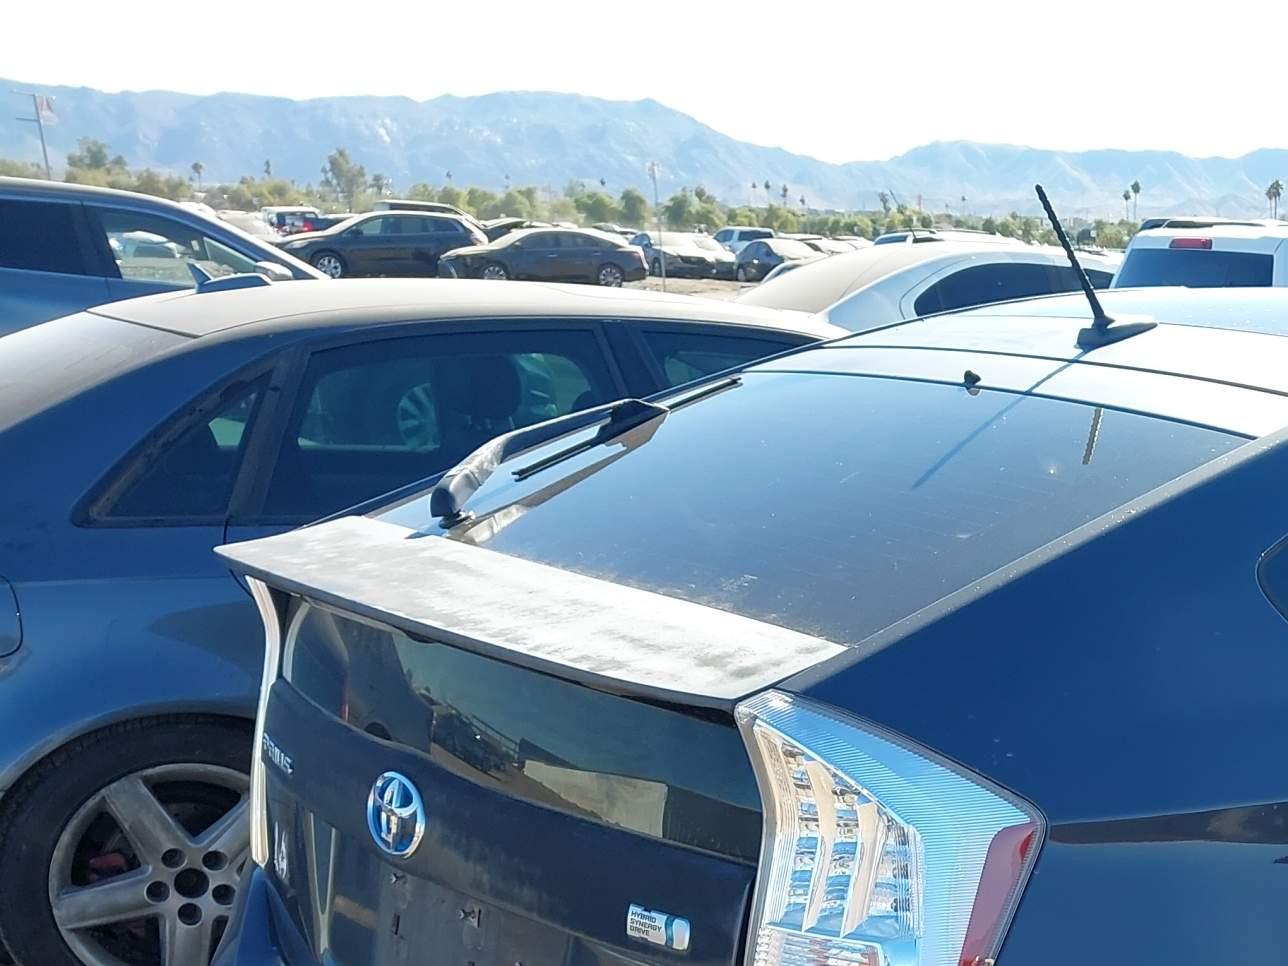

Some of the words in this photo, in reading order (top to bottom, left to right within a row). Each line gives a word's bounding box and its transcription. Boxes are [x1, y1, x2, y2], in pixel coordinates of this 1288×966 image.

[630, 910, 657, 924] HYBRID
[629, 917, 662, 933] SYNERGY
[629, 925, 650, 937] DRIVE
